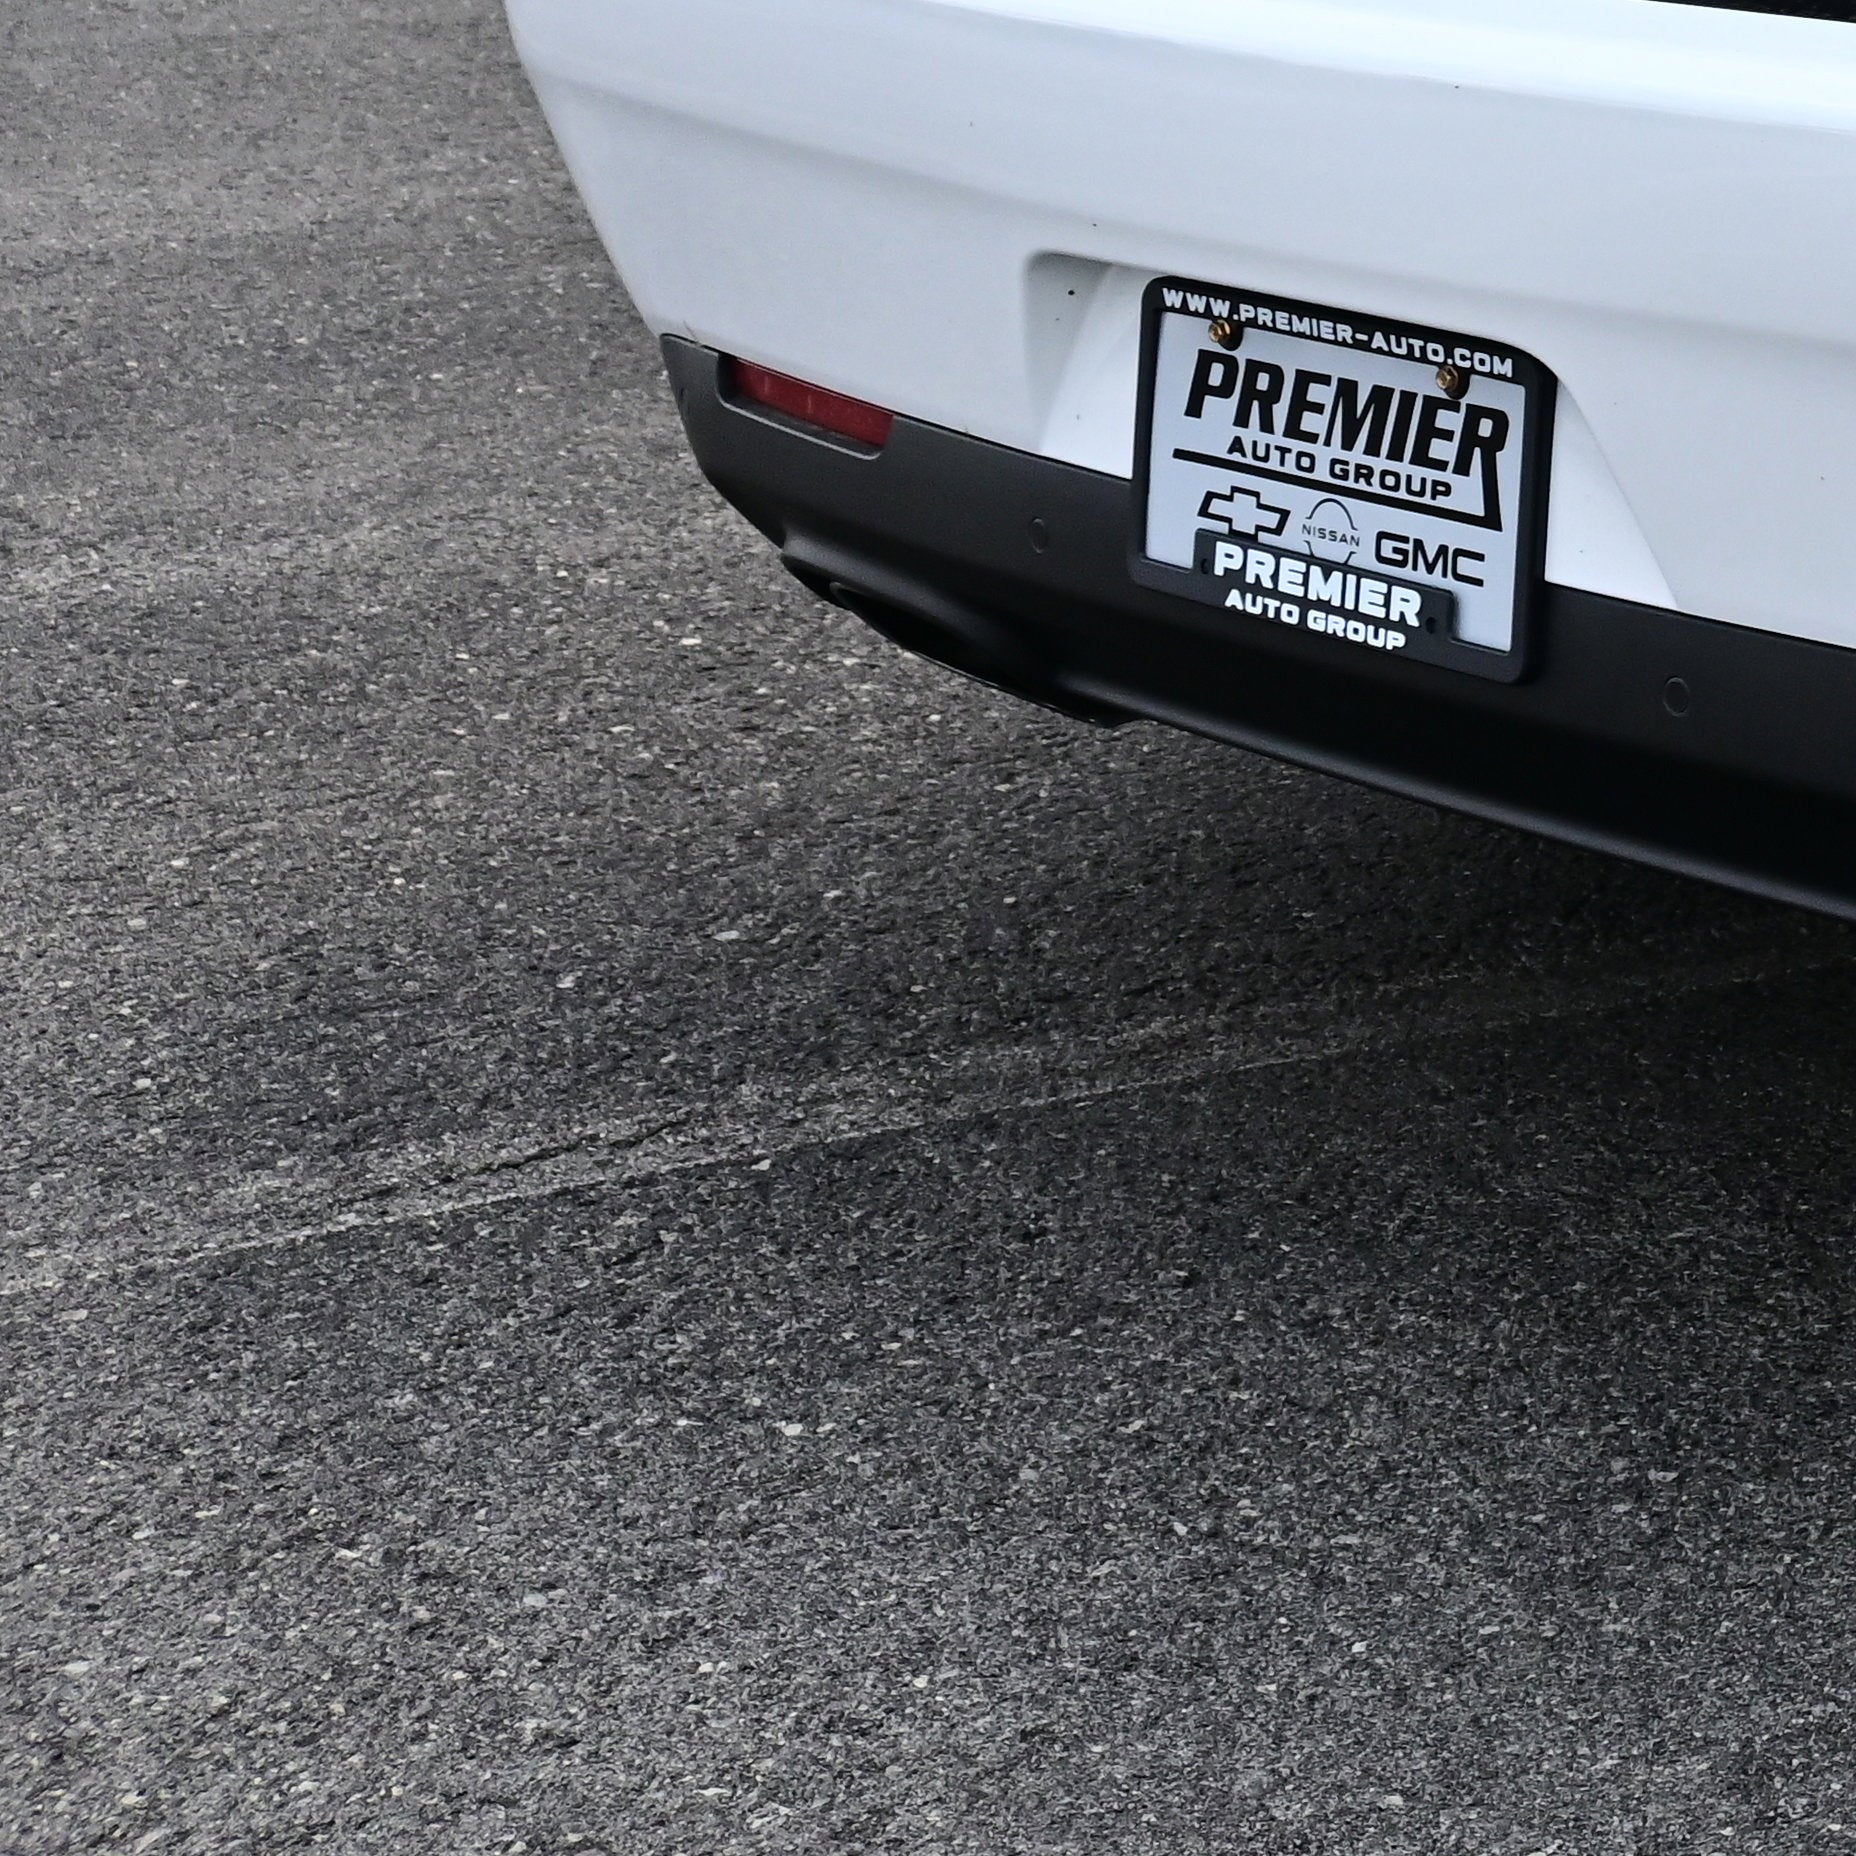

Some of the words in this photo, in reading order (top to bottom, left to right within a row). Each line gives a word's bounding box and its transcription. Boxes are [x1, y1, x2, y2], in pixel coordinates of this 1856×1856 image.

[1162, 287, 1513, 378] WWW.PREMIER-AUTO.COM
[1184, 348, 1510, 532] PREMIER
[1226, 435, 1317, 475] AUTO
[1329, 458, 1452, 501] GROUP
[1213, 545, 1422, 627] PREMIER
[1301, 522, 1360, 548] NISSAN
[1375, 530, 1485, 587] GMC
[1224, 589, 1301, 626] AUTO
[1306, 611, 1406, 651] GROUP
